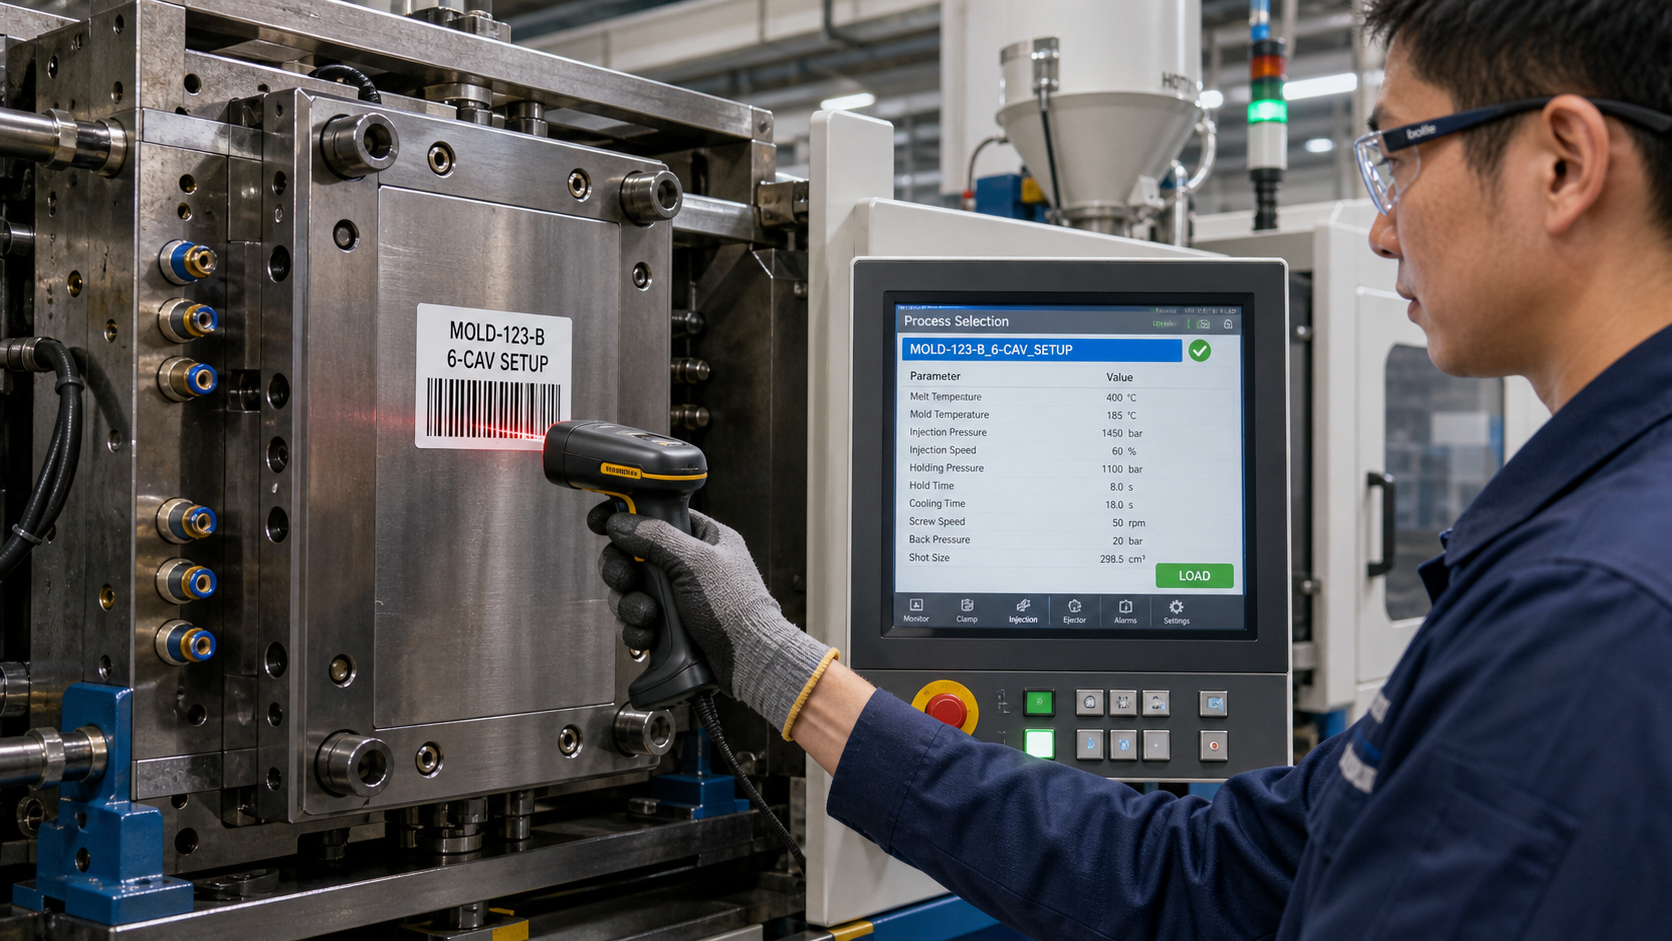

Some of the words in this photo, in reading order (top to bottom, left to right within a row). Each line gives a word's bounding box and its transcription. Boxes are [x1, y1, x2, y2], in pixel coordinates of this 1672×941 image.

[904, 315, 951, 327] Process
[954, 315, 1009, 327] Selection
[450, 321, 544, 346] MOLD-123-B
[910, 344, 1072, 358] MOLD-123-B_6-CAV_SETUP
[447, 349, 495, 370] 6-CAV
[500, 353, 548, 373] SETUP
[910, 371, 961, 381] Parameter
[1106, 373, 1133, 383] Value
[910, 392, 929, 401] Melt
[1106, 393, 1122, 403] 400
[1126, 394, 1136, 403] °C
[909, 410, 931, 419] Mold
[934, 410, 989, 421] Temperature
[1107, 411, 1122, 420] 185
[1127, 412, 1136, 421] °C
[909, 428, 947, 438] Injection
[949, 428, 987, 437] Pressure
[1102, 429, 1123, 438] 1450
[1128, 429, 1142, 438] bar
[909, 446, 946, 457] Injection
[949, 446, 976, 457] Speed
[1111, 447, 1123, 456] 60
[1127, 447, 1136, 456] %
[909, 463, 943, 475] Holding
[946, 463, 984, 473] Pressure
[1102, 465, 1123, 474] 1100
[1128, 465, 1143, 474] bar
[909, 481, 930, 490] Hold
[933, 481, 954, 491] Time
[1109, 483, 1123, 492] 8.0
[909, 499, 942, 510] Cooling
[944, 499, 965, 508] Time
[1105, 501, 1123, 510] 18.0
[909, 517, 936, 526] Screw
[937, 517, 965, 528] Speed
[1112, 519, 1123, 528] 50
[1128, 521, 1145, 529] rpm
[909, 535, 930, 544] Back
[932, 535, 970, 545] Pressure
[1112, 537, 1123, 546] 20
[1128, 537, 1142, 546] bar
[908, 553, 929, 562] Shot
[931, 553, 950, 563] Size
[1099, 555, 1124, 564] 298.5
[1179, 571, 1210, 582] LOAD
[903, 615, 929, 623] Monitor
[956, 615, 978, 625] Clamp
[1008, 616, 1037, 625] Injection
[1063, 616, 1086, 625] Ejector
[1113, 617, 1137, 625] Alarms
[1163, 617, 1190, 627] Settings
